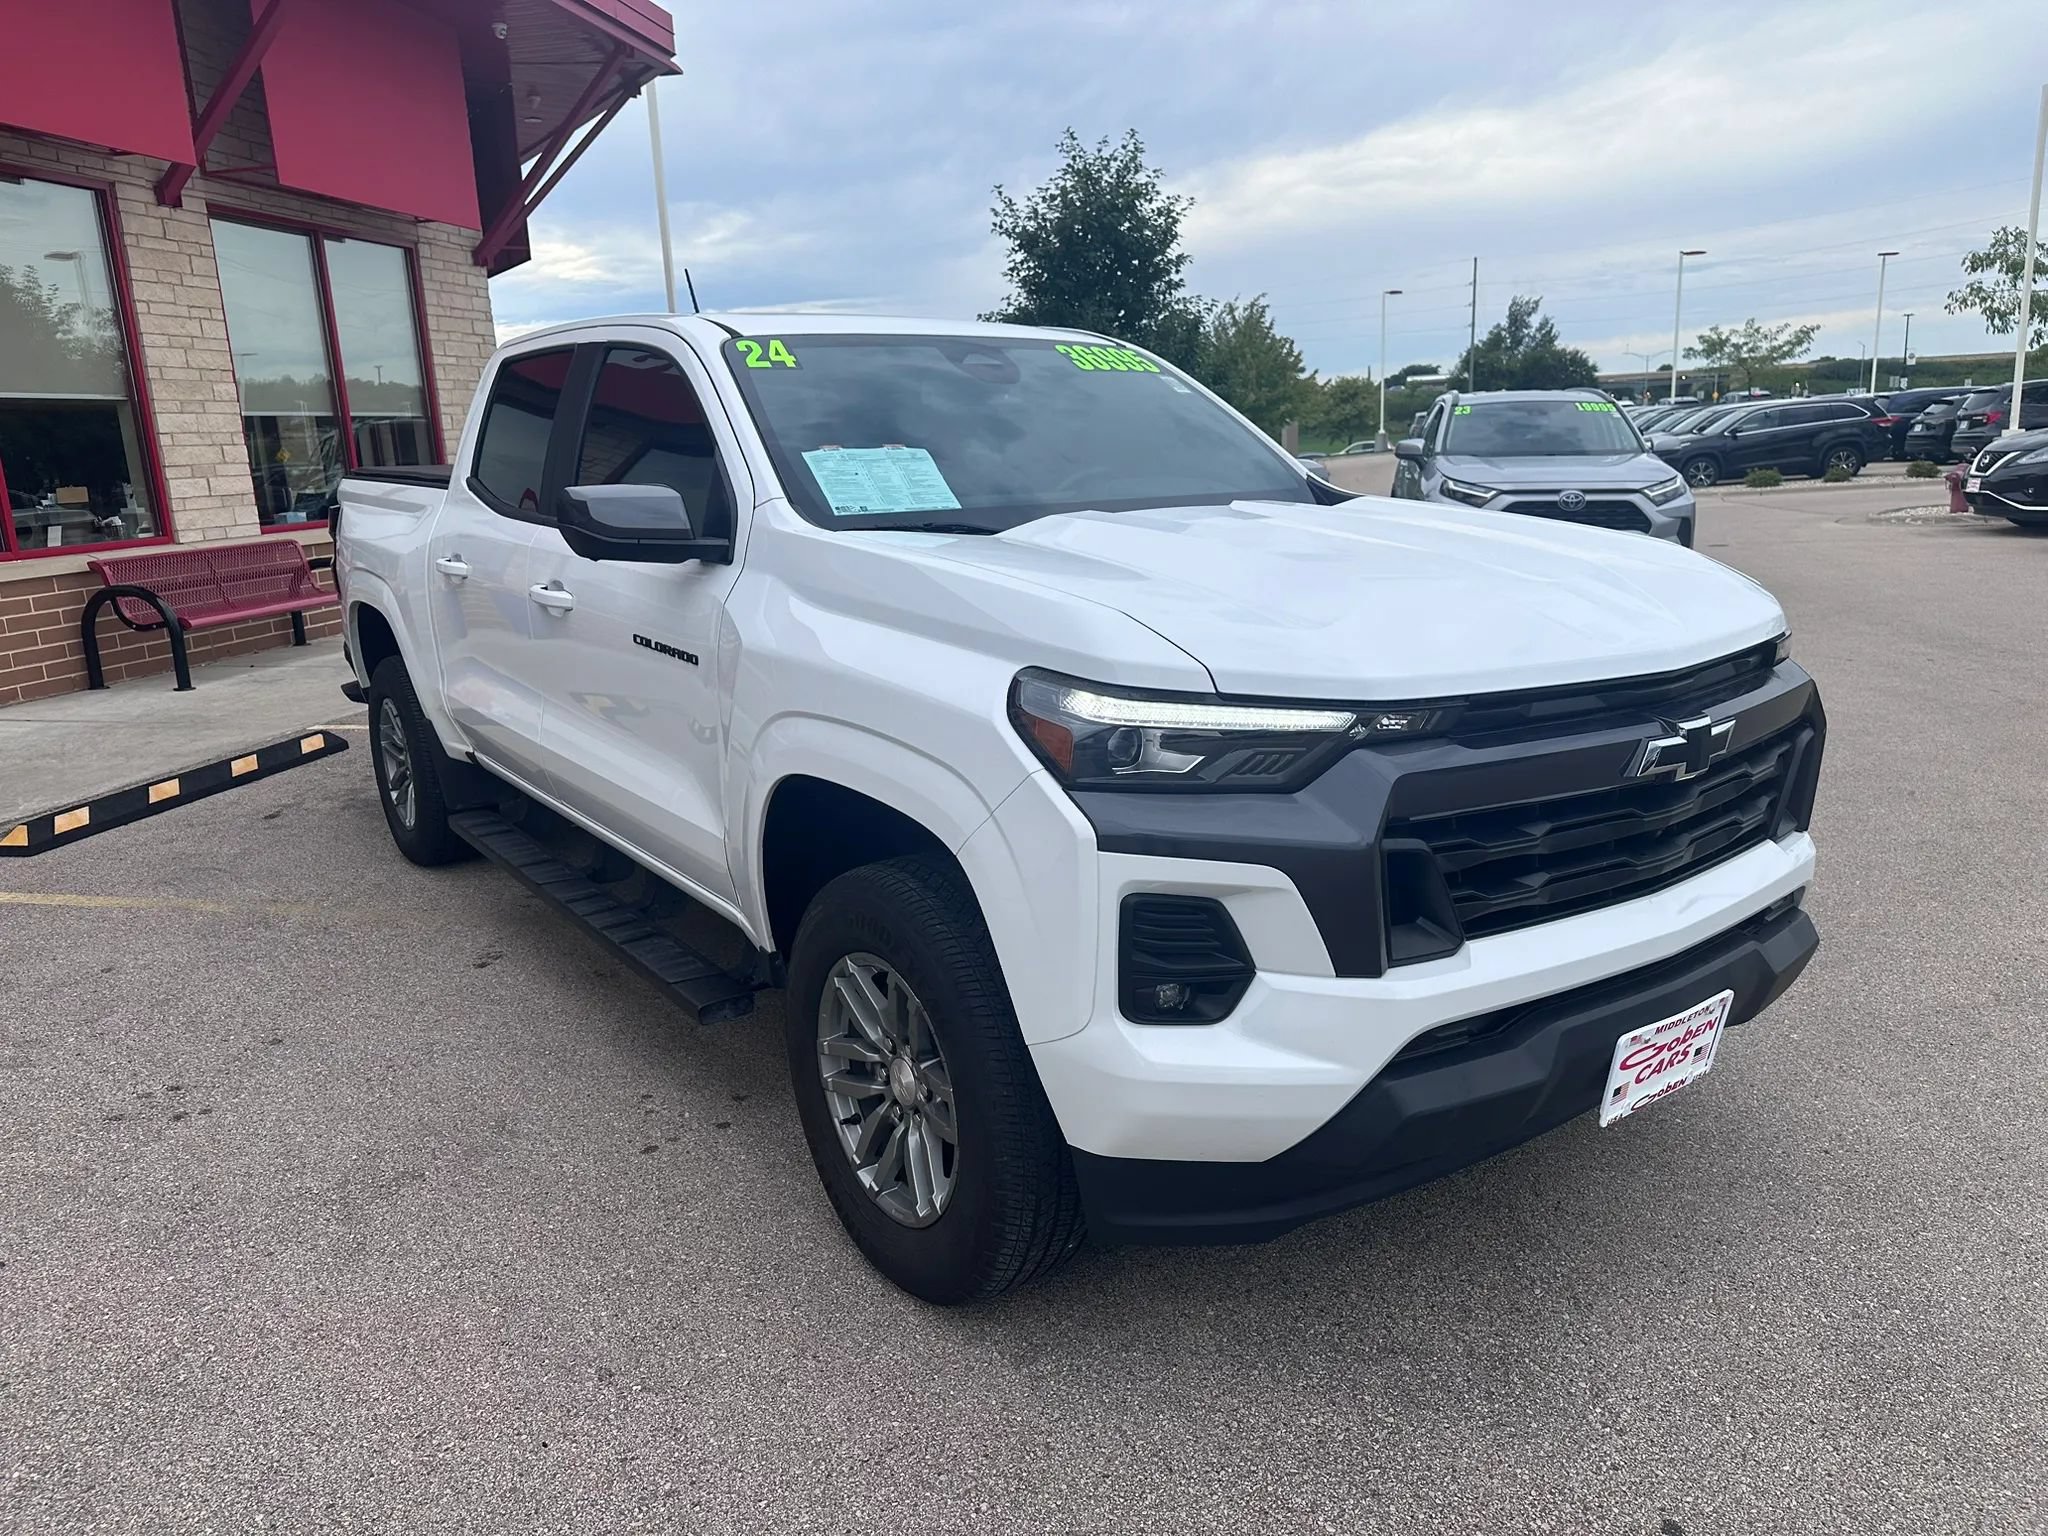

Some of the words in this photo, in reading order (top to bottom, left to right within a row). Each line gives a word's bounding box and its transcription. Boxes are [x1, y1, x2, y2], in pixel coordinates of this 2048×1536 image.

[735, 339, 797, 369] 24
[1055, 344, 1161, 374] 36995
[1454, 405, 1472, 416] 23
[632, 633, 699, 666] COLORADO
[1654, 1003, 1712, 1035] MIDDLETON
[1634, 1043, 1693, 1085] CARS
